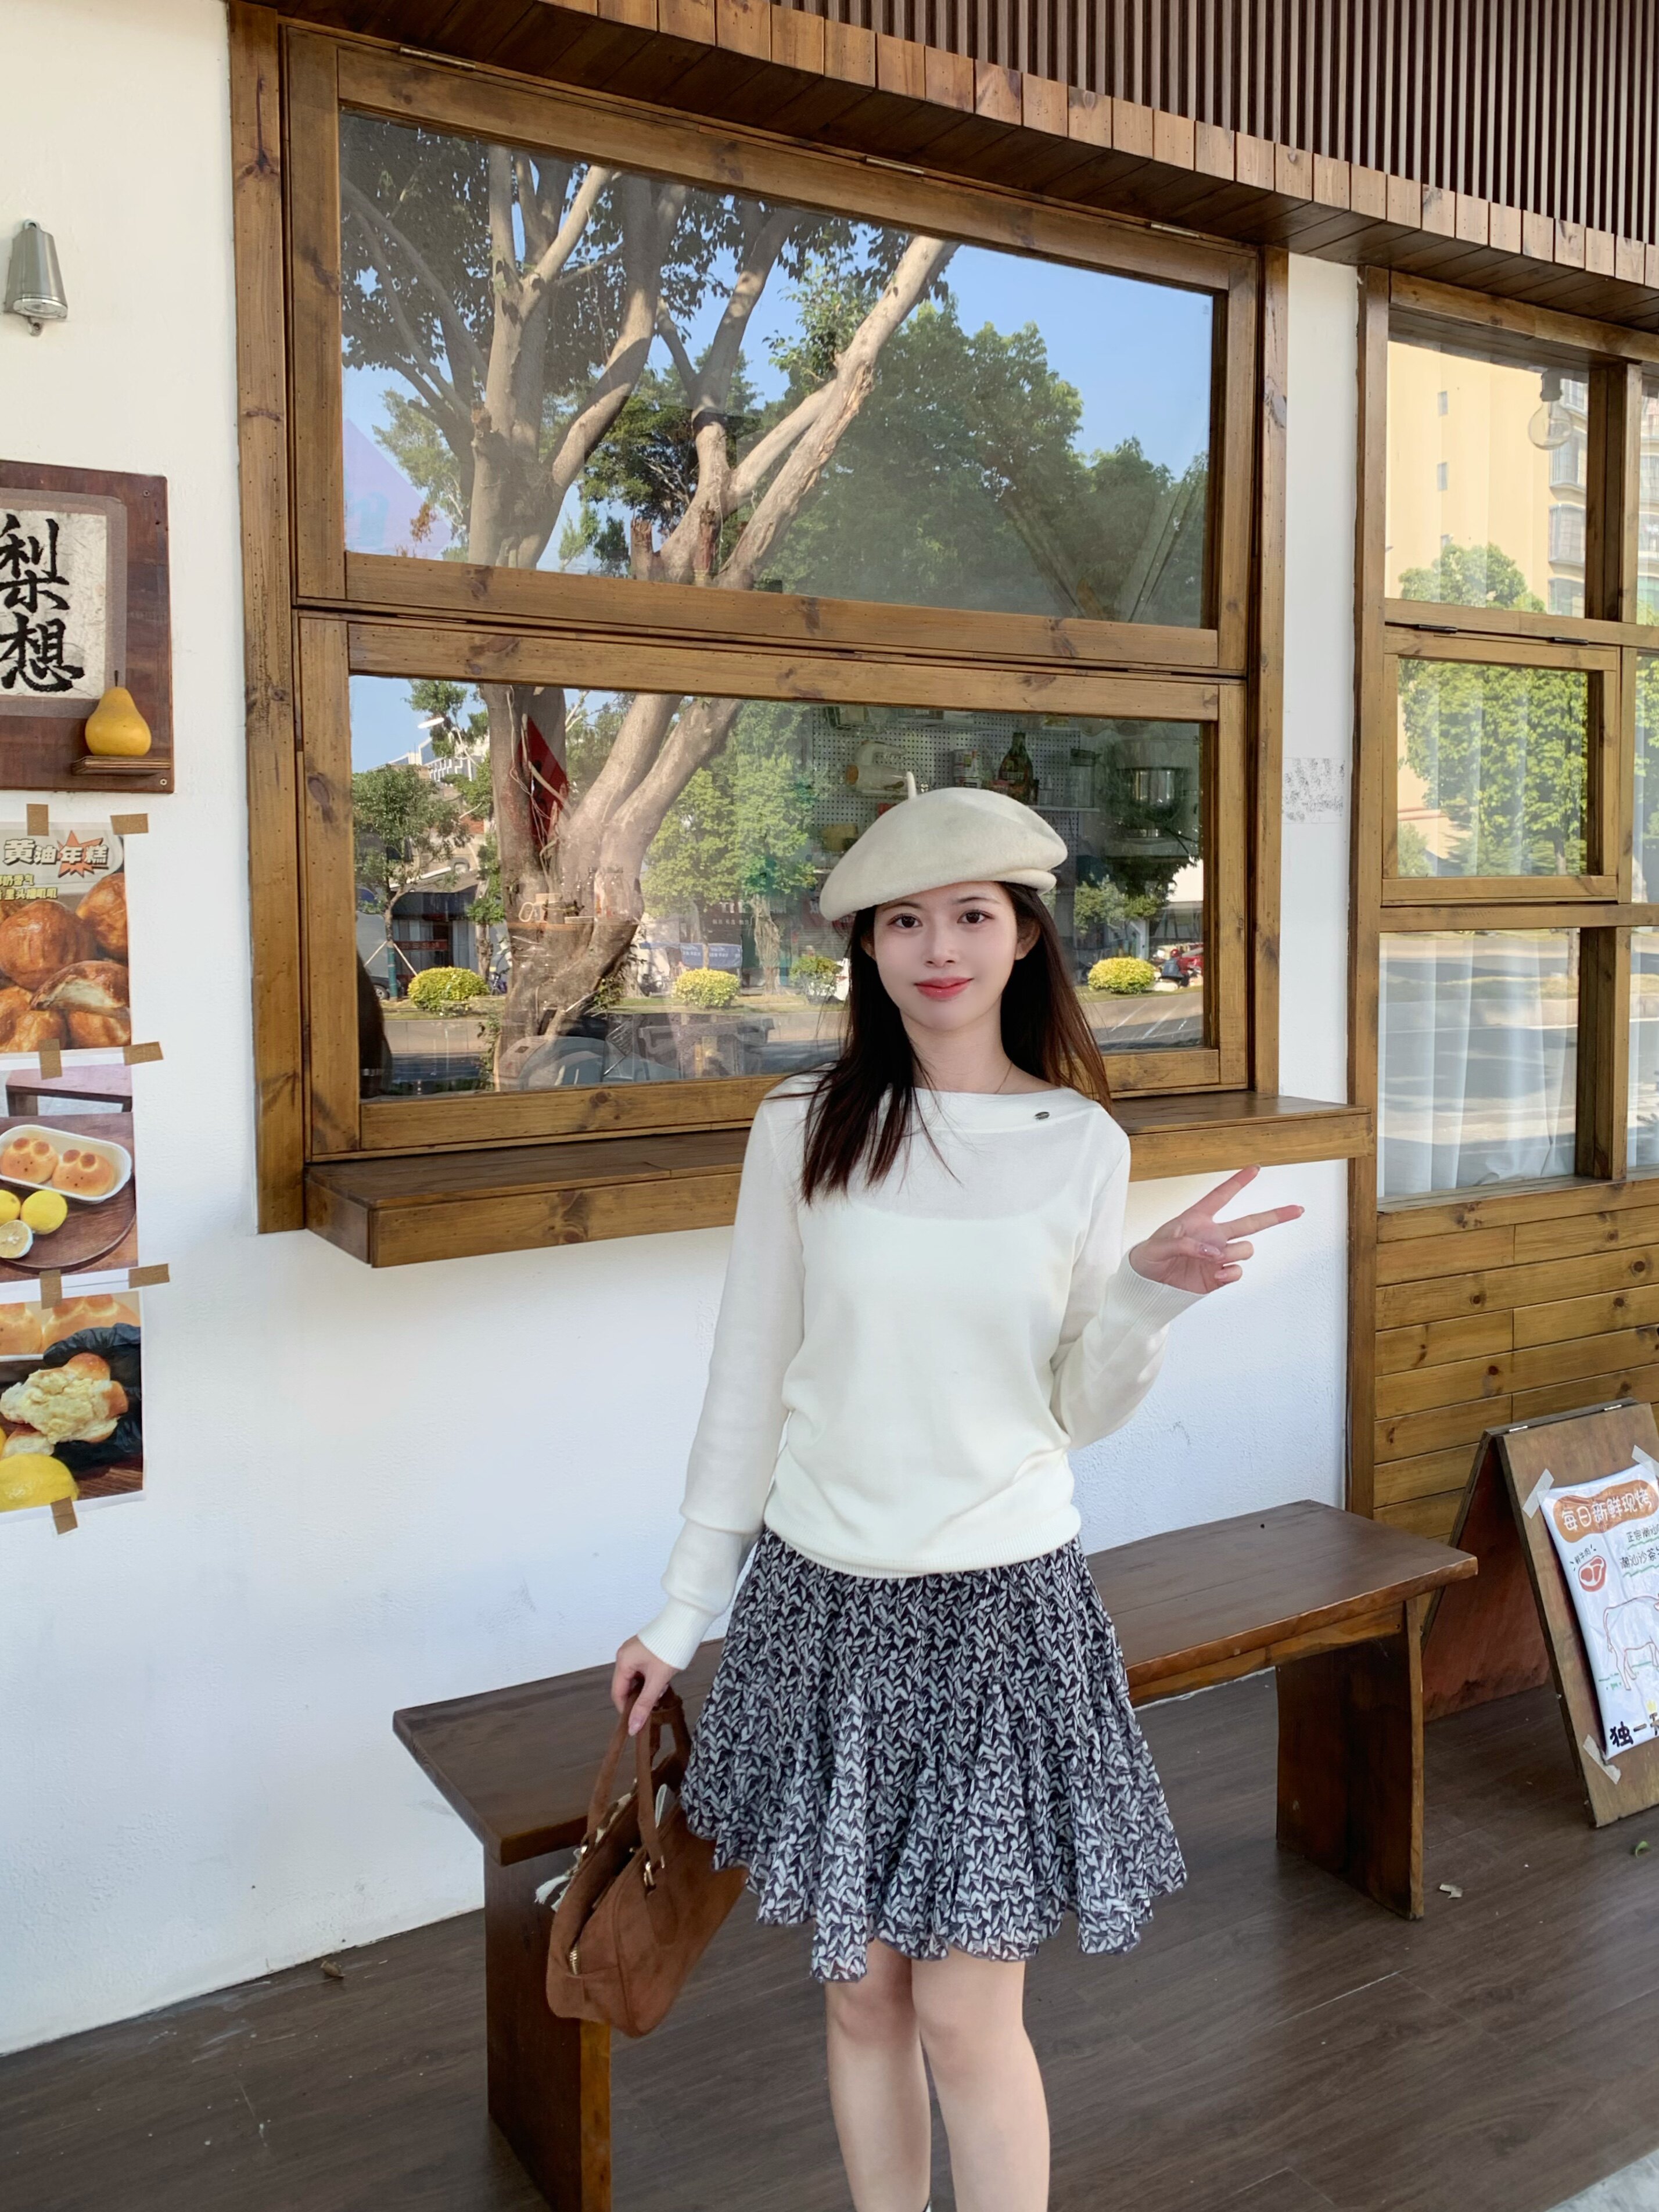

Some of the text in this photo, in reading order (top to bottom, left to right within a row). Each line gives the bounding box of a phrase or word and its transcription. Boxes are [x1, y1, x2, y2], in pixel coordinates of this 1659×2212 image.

[3, 838, 109, 866] 黄油年糕
[0, 874, 34, 886] 奶香气
[1562, 1488, 1652, 1531] 每日新鲜现烤
[1626, 1524, 1659, 1542] 正宗潮汕
[1619, 1546, 1659, 1569] 潮汕沙茶
